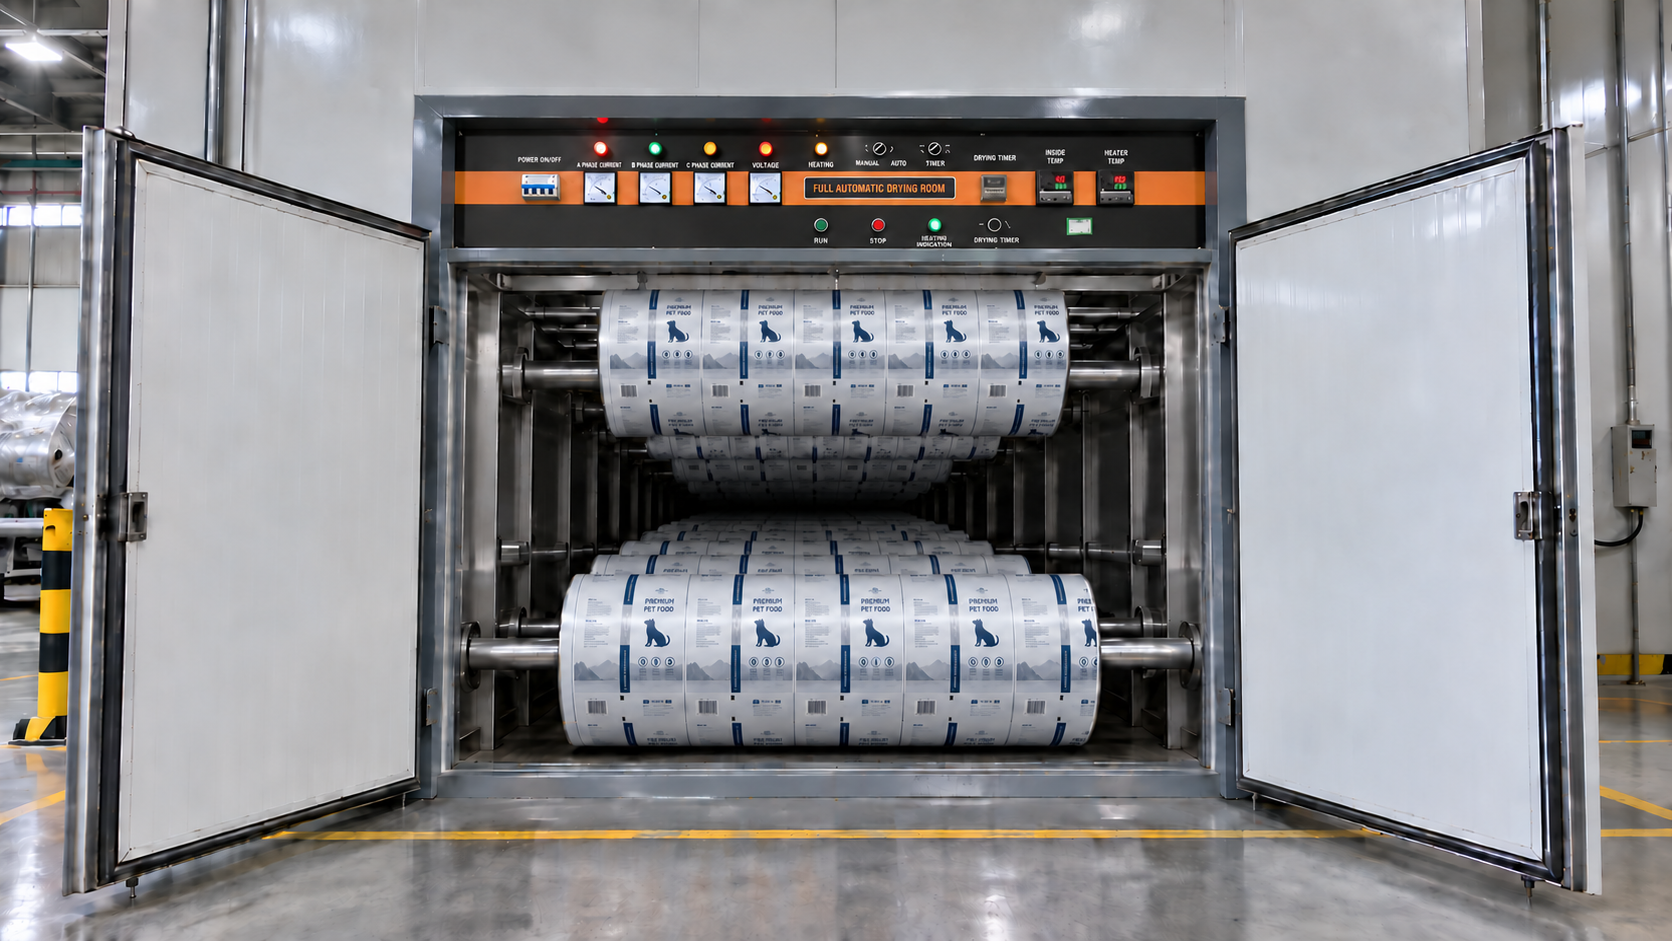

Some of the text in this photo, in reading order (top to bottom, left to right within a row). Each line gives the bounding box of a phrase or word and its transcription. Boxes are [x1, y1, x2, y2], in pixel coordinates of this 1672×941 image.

[813, 183, 946, 193] FULL AUTOMATIC DRYING ROOM
